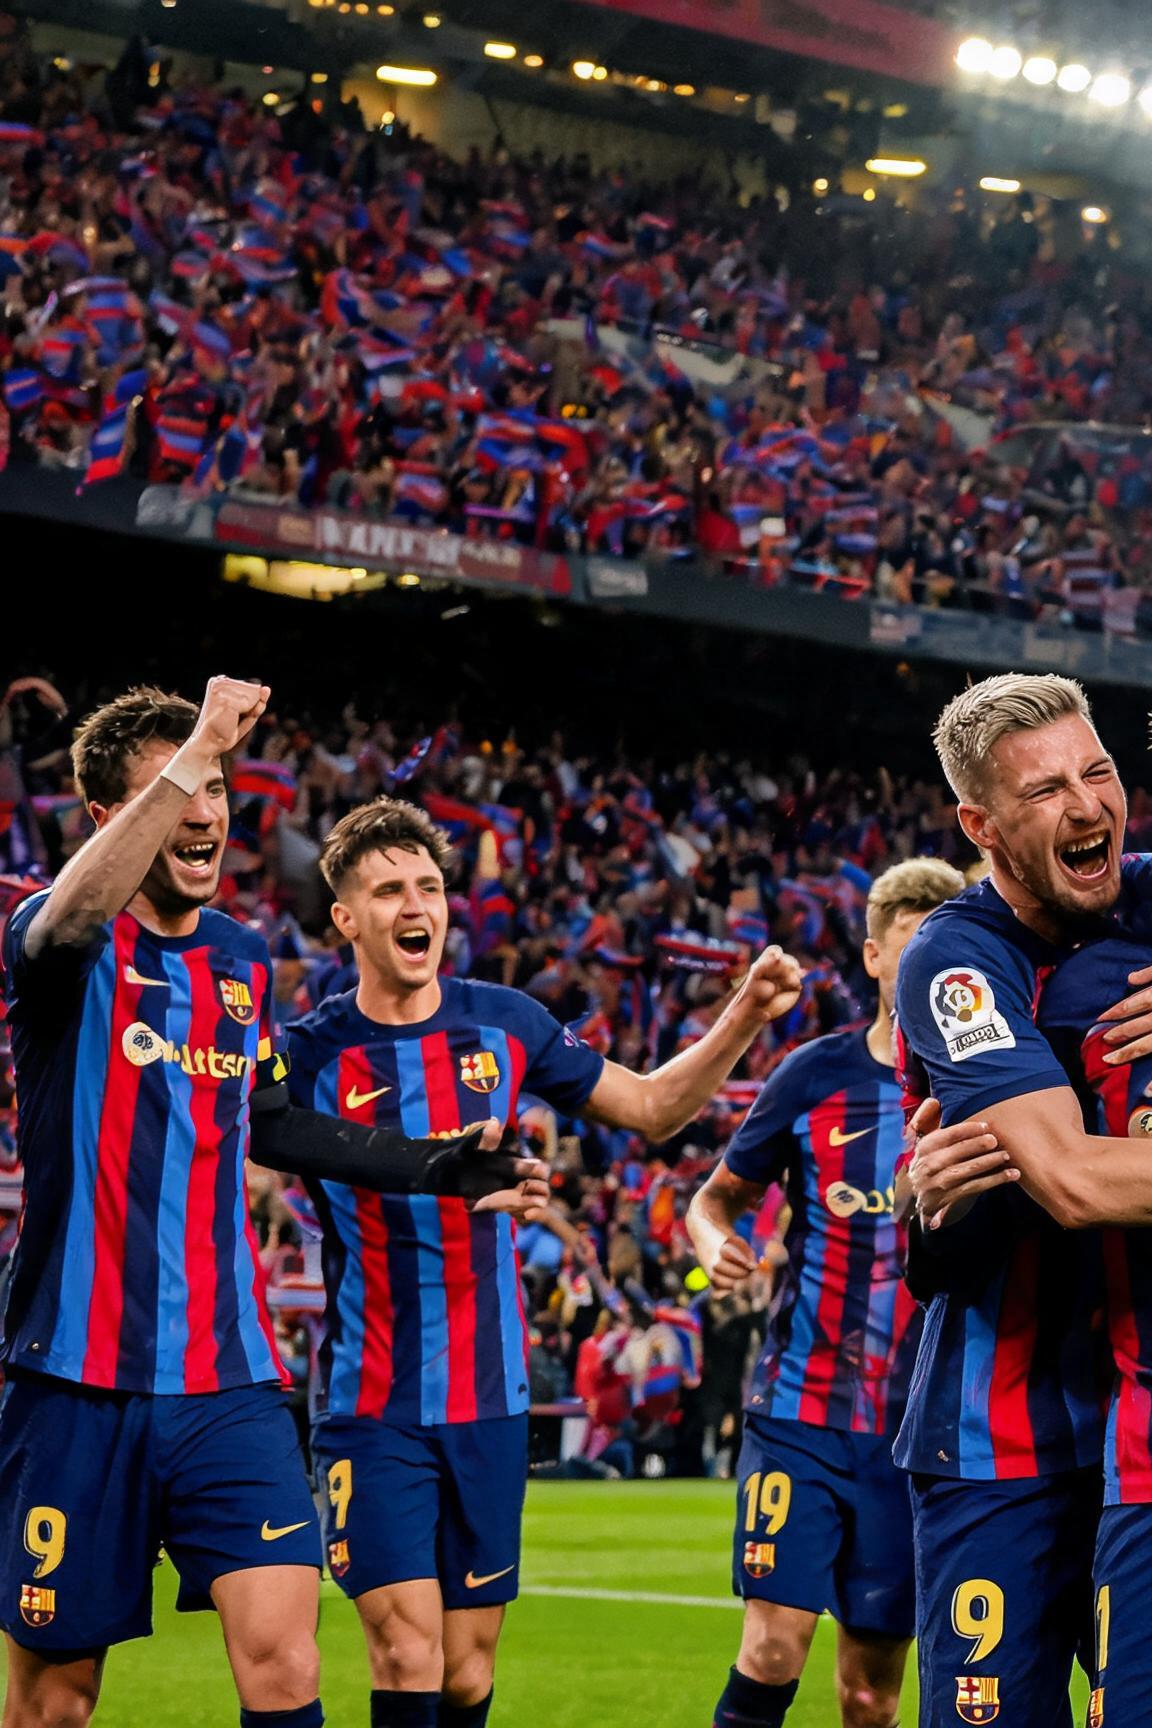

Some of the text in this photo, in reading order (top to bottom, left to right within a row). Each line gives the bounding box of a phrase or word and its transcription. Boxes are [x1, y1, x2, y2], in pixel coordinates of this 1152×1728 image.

[743, 1471, 792, 1535] 19
[24, 1506, 67, 1578] 9
[951, 1578, 1004, 1664] 9
